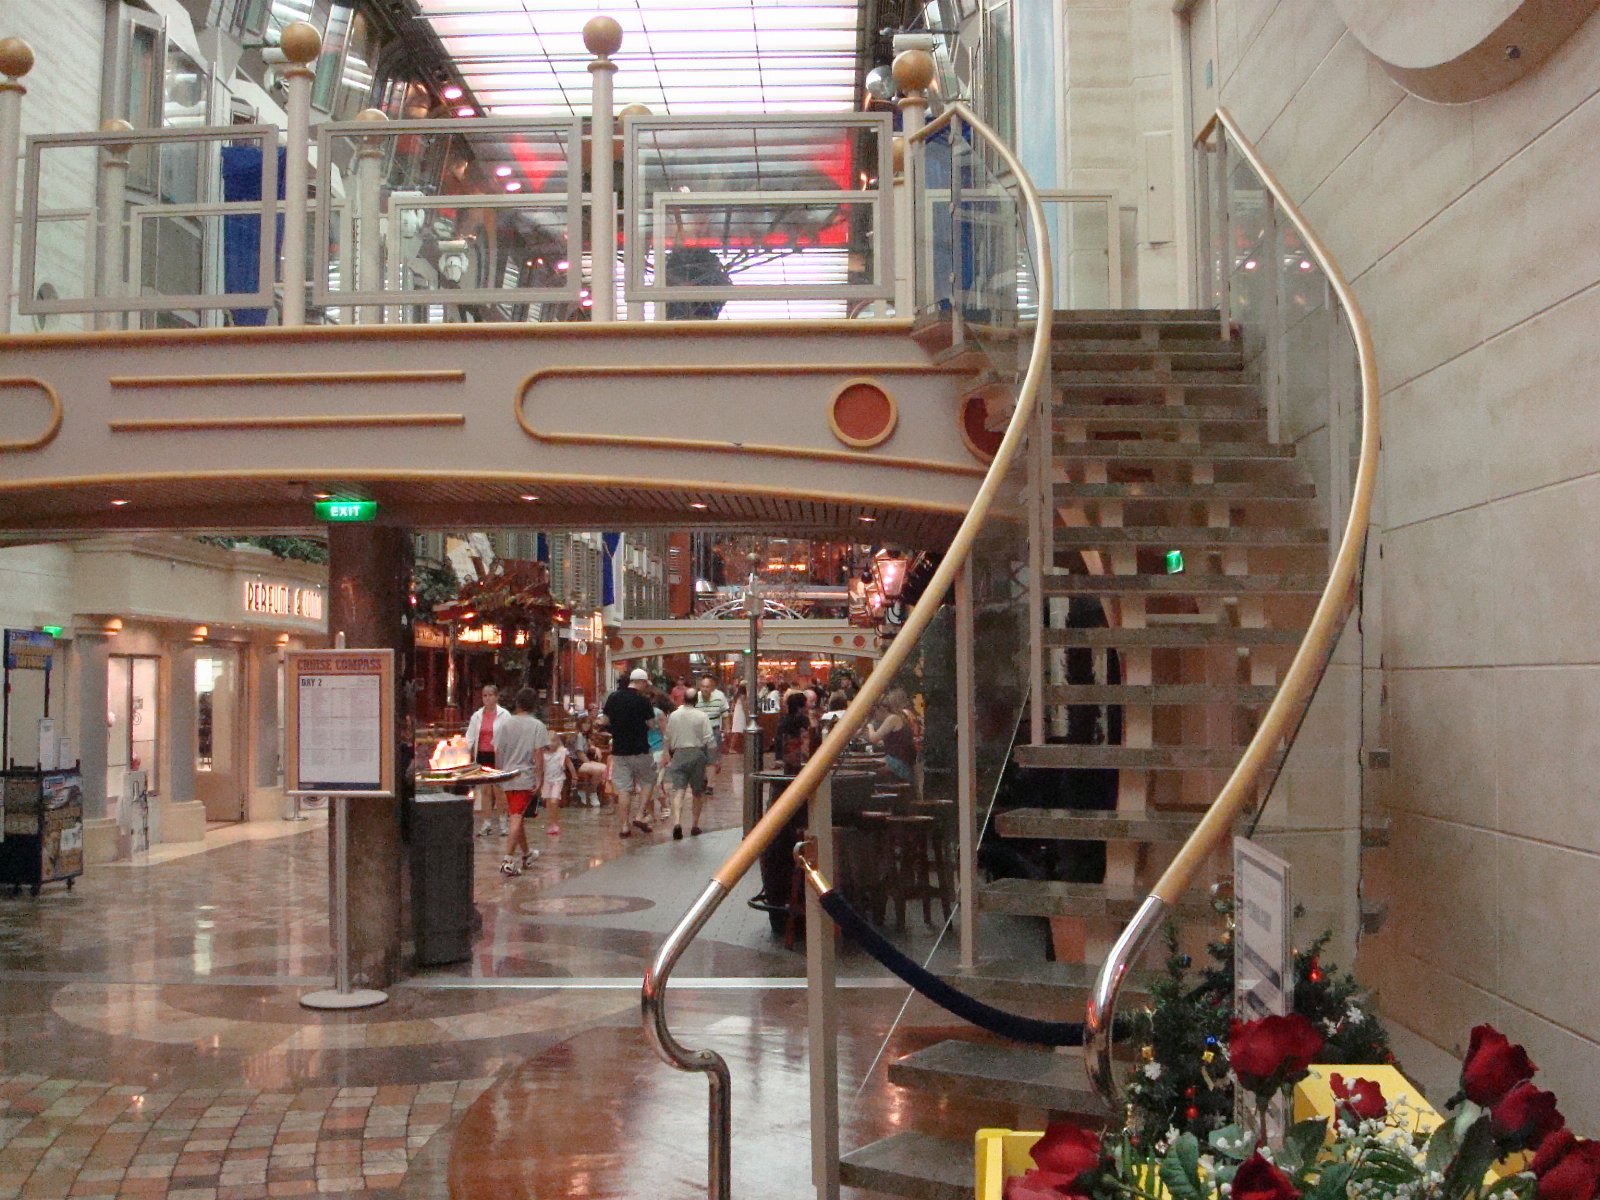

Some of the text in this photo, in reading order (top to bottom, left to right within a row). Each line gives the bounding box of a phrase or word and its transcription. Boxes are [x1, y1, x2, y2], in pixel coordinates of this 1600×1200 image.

[330, 506, 360, 516] EXIT
[297, 659, 382, 670] CRUISE COMPASS
[301, 678, 316, 687] DAY
